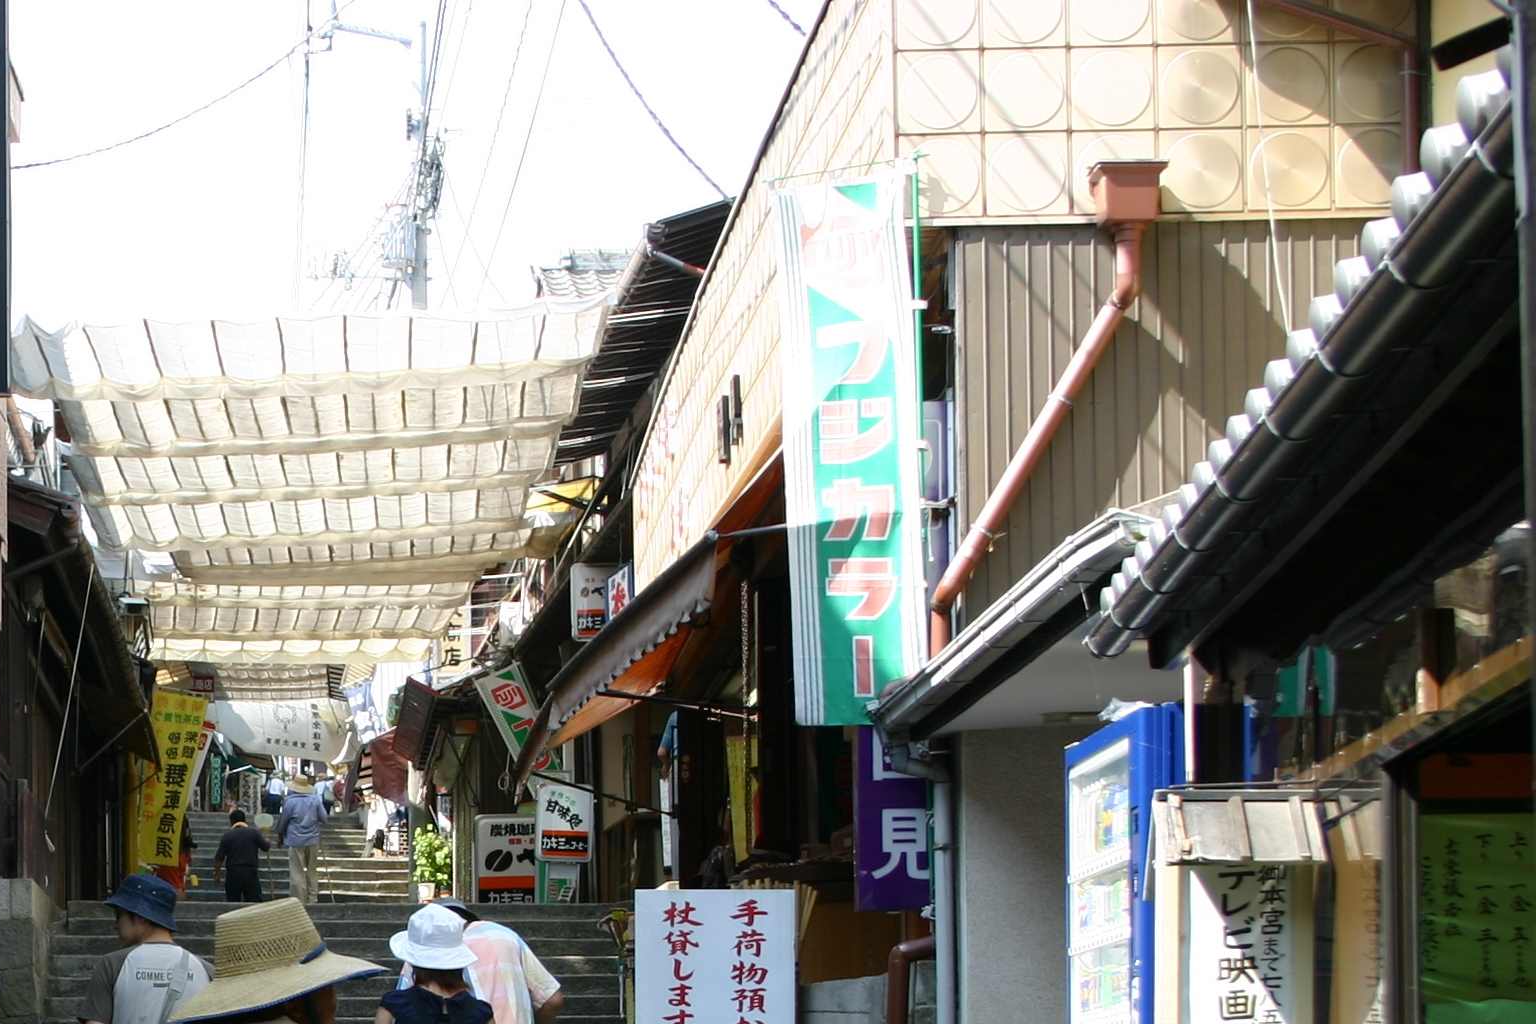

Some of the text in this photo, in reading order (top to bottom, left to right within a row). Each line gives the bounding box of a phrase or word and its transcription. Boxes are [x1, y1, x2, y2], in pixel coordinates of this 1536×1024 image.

[815, 318, 900, 699] フジカラー
